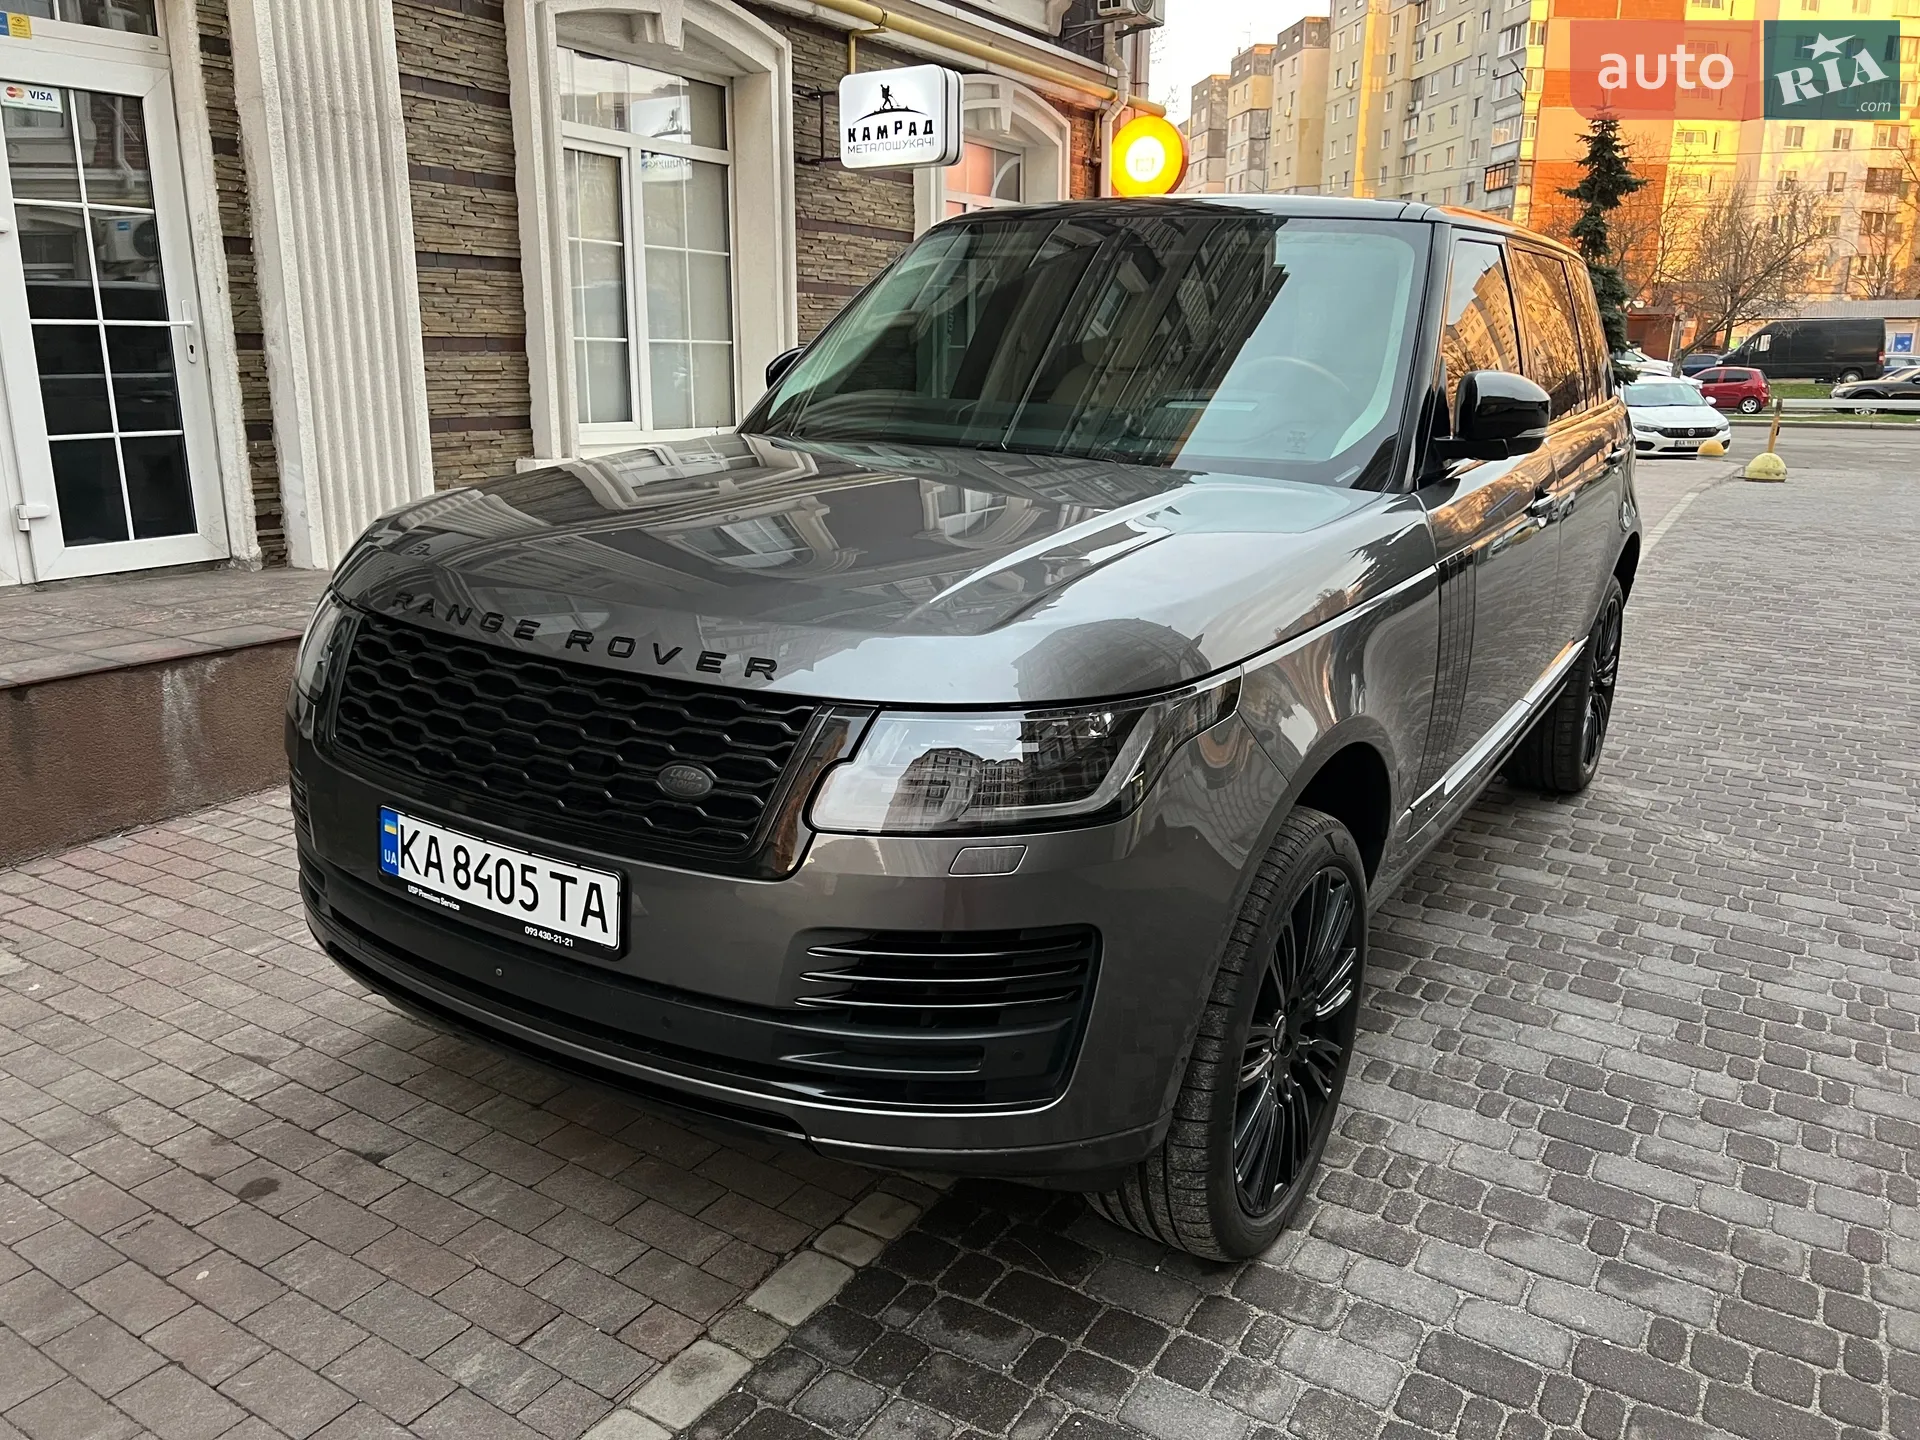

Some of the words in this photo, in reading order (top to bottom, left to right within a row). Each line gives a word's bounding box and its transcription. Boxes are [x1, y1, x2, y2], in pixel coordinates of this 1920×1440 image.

[28, 90, 53, 101] VISA
[848, 119, 934, 143] КАМРАД
[847, 137, 935, 154] МЕТАЛОШУКАЧІ
[391, 591, 541, 641] RANGE
[565, 629, 778, 681] ROVER
[384, 849, 398, 866] UA
[400, 823, 445, 884] KA
[453, 844, 539, 912] 8405
[549, 870, 609, 934] TA
[441, 897, 459, 910] Service
[525, 926, 538, 937] 093
[539, 930, 573, 947] 430-21-21
